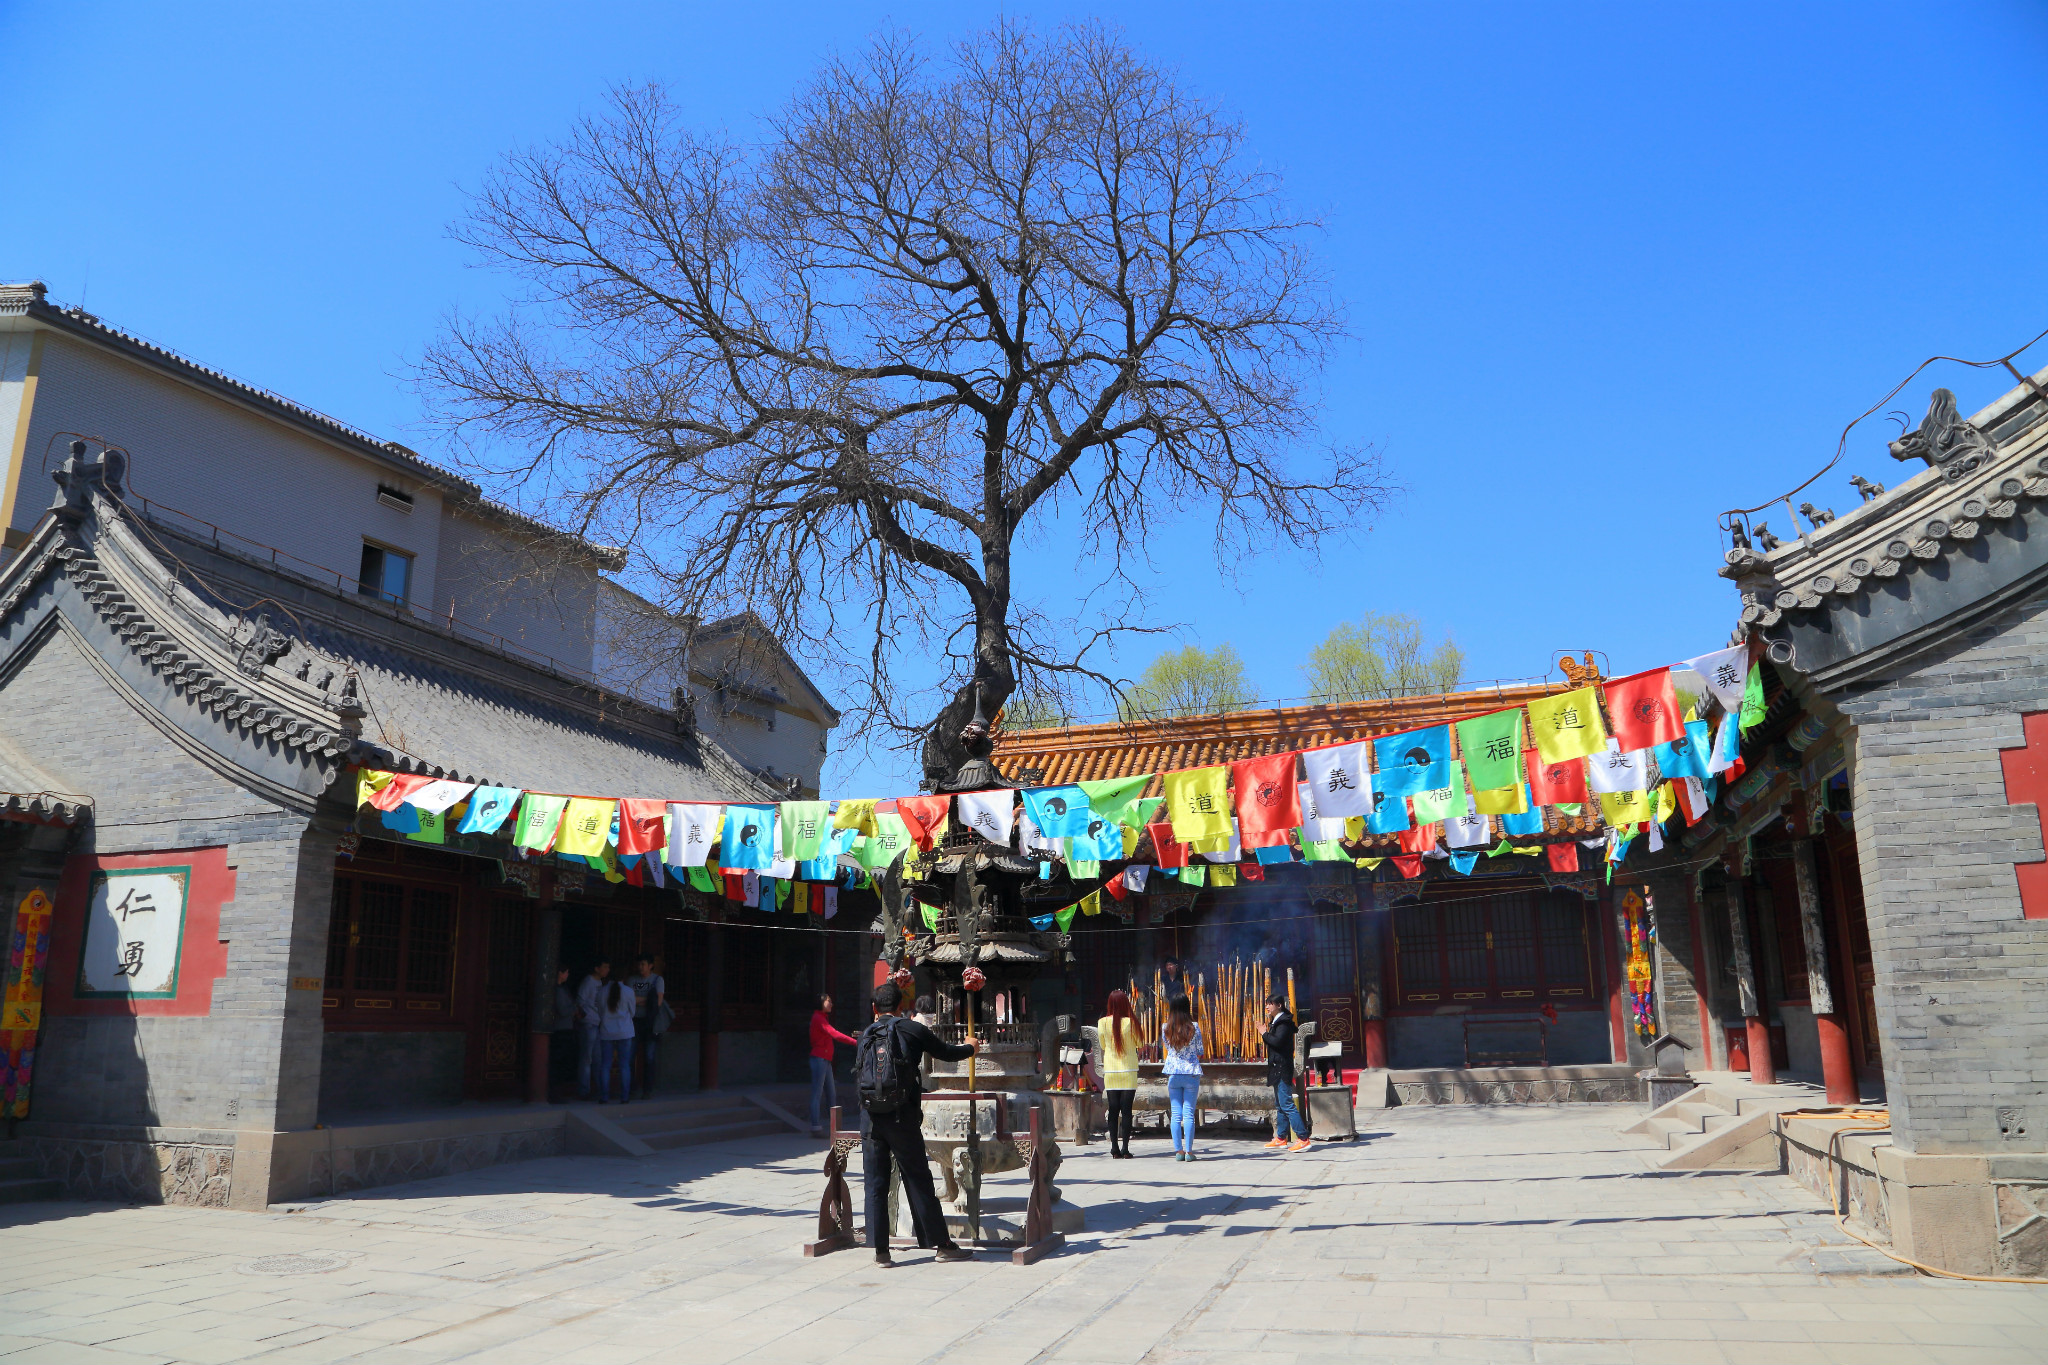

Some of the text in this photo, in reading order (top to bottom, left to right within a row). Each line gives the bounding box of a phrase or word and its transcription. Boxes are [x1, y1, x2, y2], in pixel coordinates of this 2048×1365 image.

[1717, 664, 1740, 688] 義
[1553, 707, 1586, 729] 道
[1486, 735, 1514, 761] 福
[1609, 751, 1632, 768] 義
[1329, 768, 1355, 792] 義
[1190, 793, 1218, 814] 道
[420, 811, 435, 828] 福
[528, 809, 548, 827] 福
[577, 816, 598, 835] 道
[974, 811, 998, 830] 義
[688, 824, 702, 844] 義
[797, 820, 816, 838] 福
[877, 834, 897, 849] 福
[114, 888, 156, 977] 仁勇
